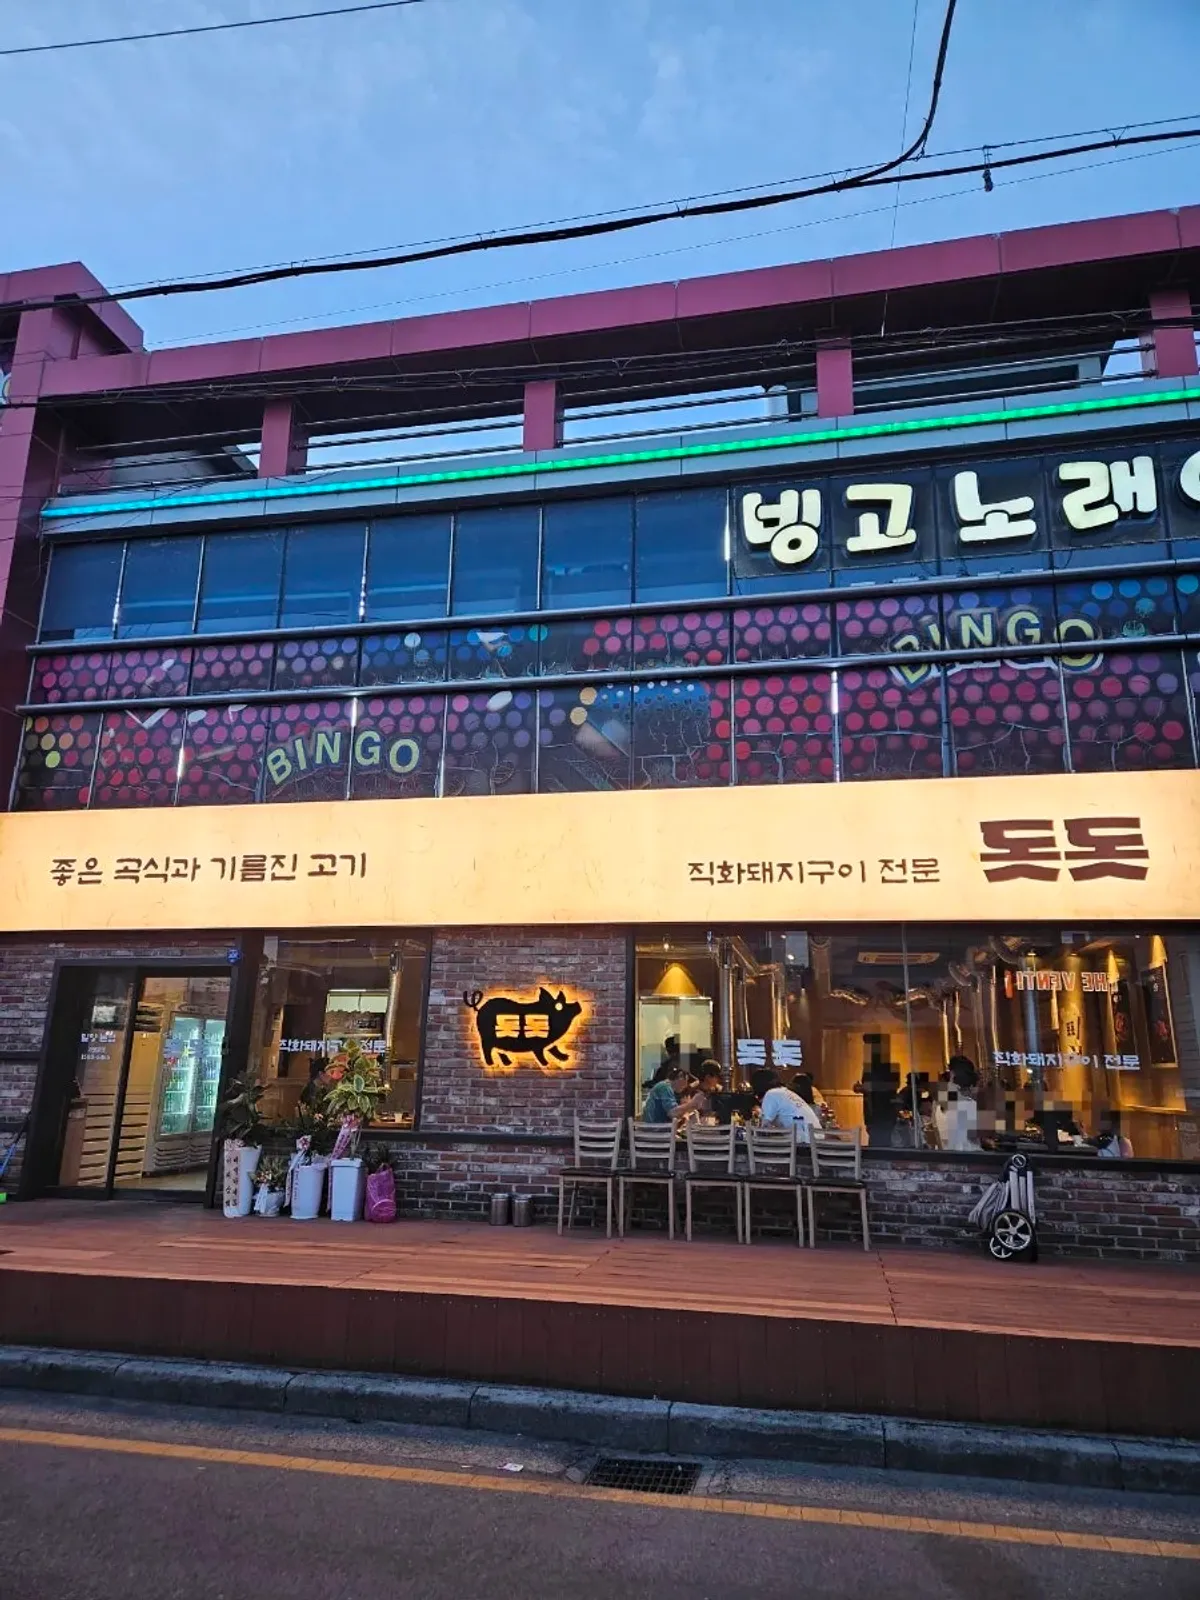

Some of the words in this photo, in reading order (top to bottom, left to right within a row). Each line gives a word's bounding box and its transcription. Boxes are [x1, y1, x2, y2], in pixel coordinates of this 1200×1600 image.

[266, 730, 420, 785] BINGO
[50, 857, 103, 886] 좋은
[113, 856, 200, 883] 곡식과
[210, 853, 298, 882] 기름진
[307, 852, 367, 878] 고기
[687, 860, 867, 886] 직화돼지구이
[878, 858, 940, 884] 전문
[1103, 1054, 1141, 1071] 전문
